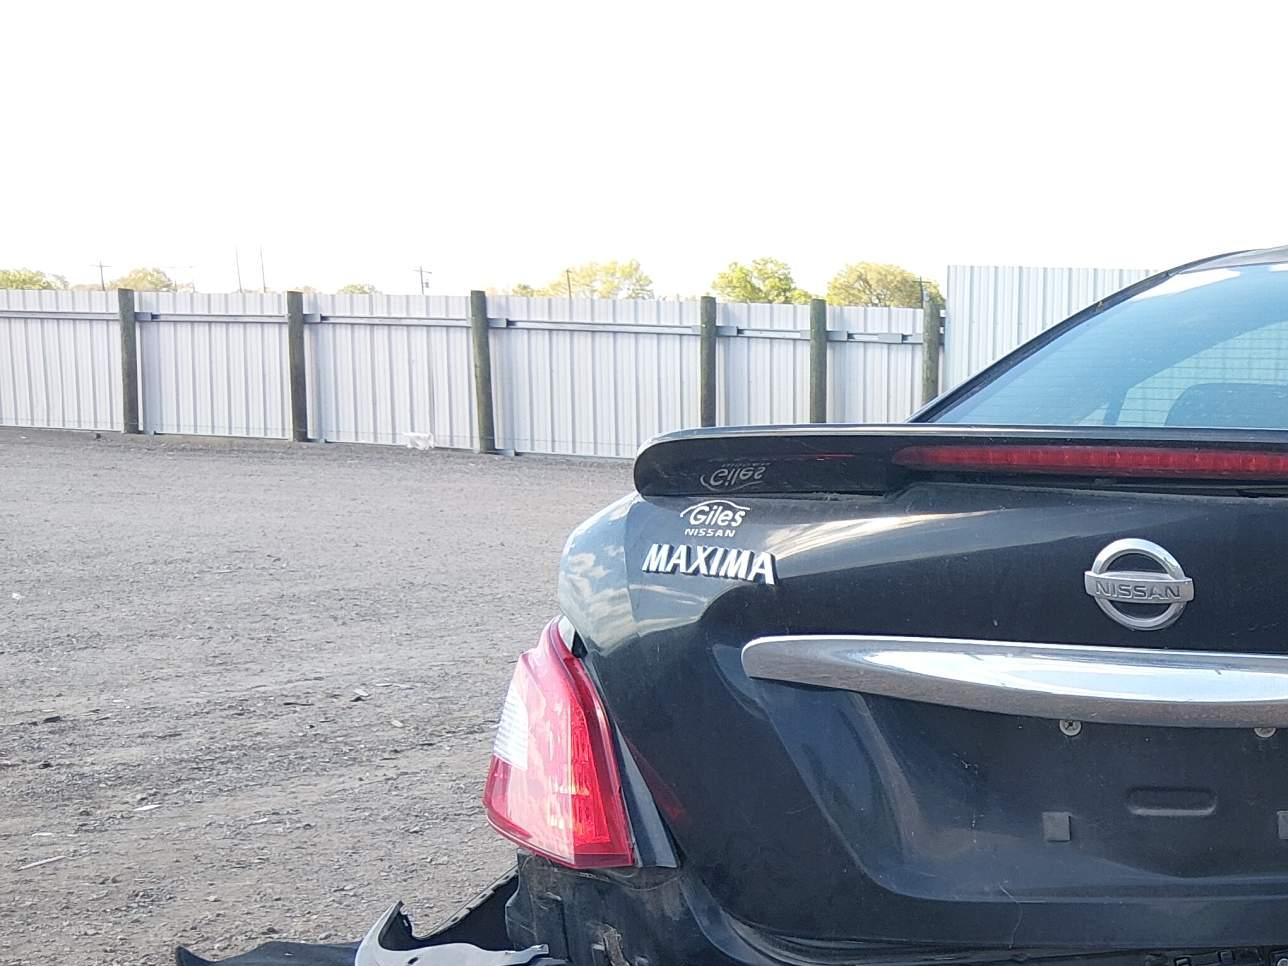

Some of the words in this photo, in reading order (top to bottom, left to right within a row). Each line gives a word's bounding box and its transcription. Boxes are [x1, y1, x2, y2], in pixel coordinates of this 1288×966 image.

[689, 504, 746, 527] Giles
[684, 528, 736, 538] NISSAN
[641, 543, 777, 585] MAXIMA
[1095, 580, 1181, 600] NISSAN
